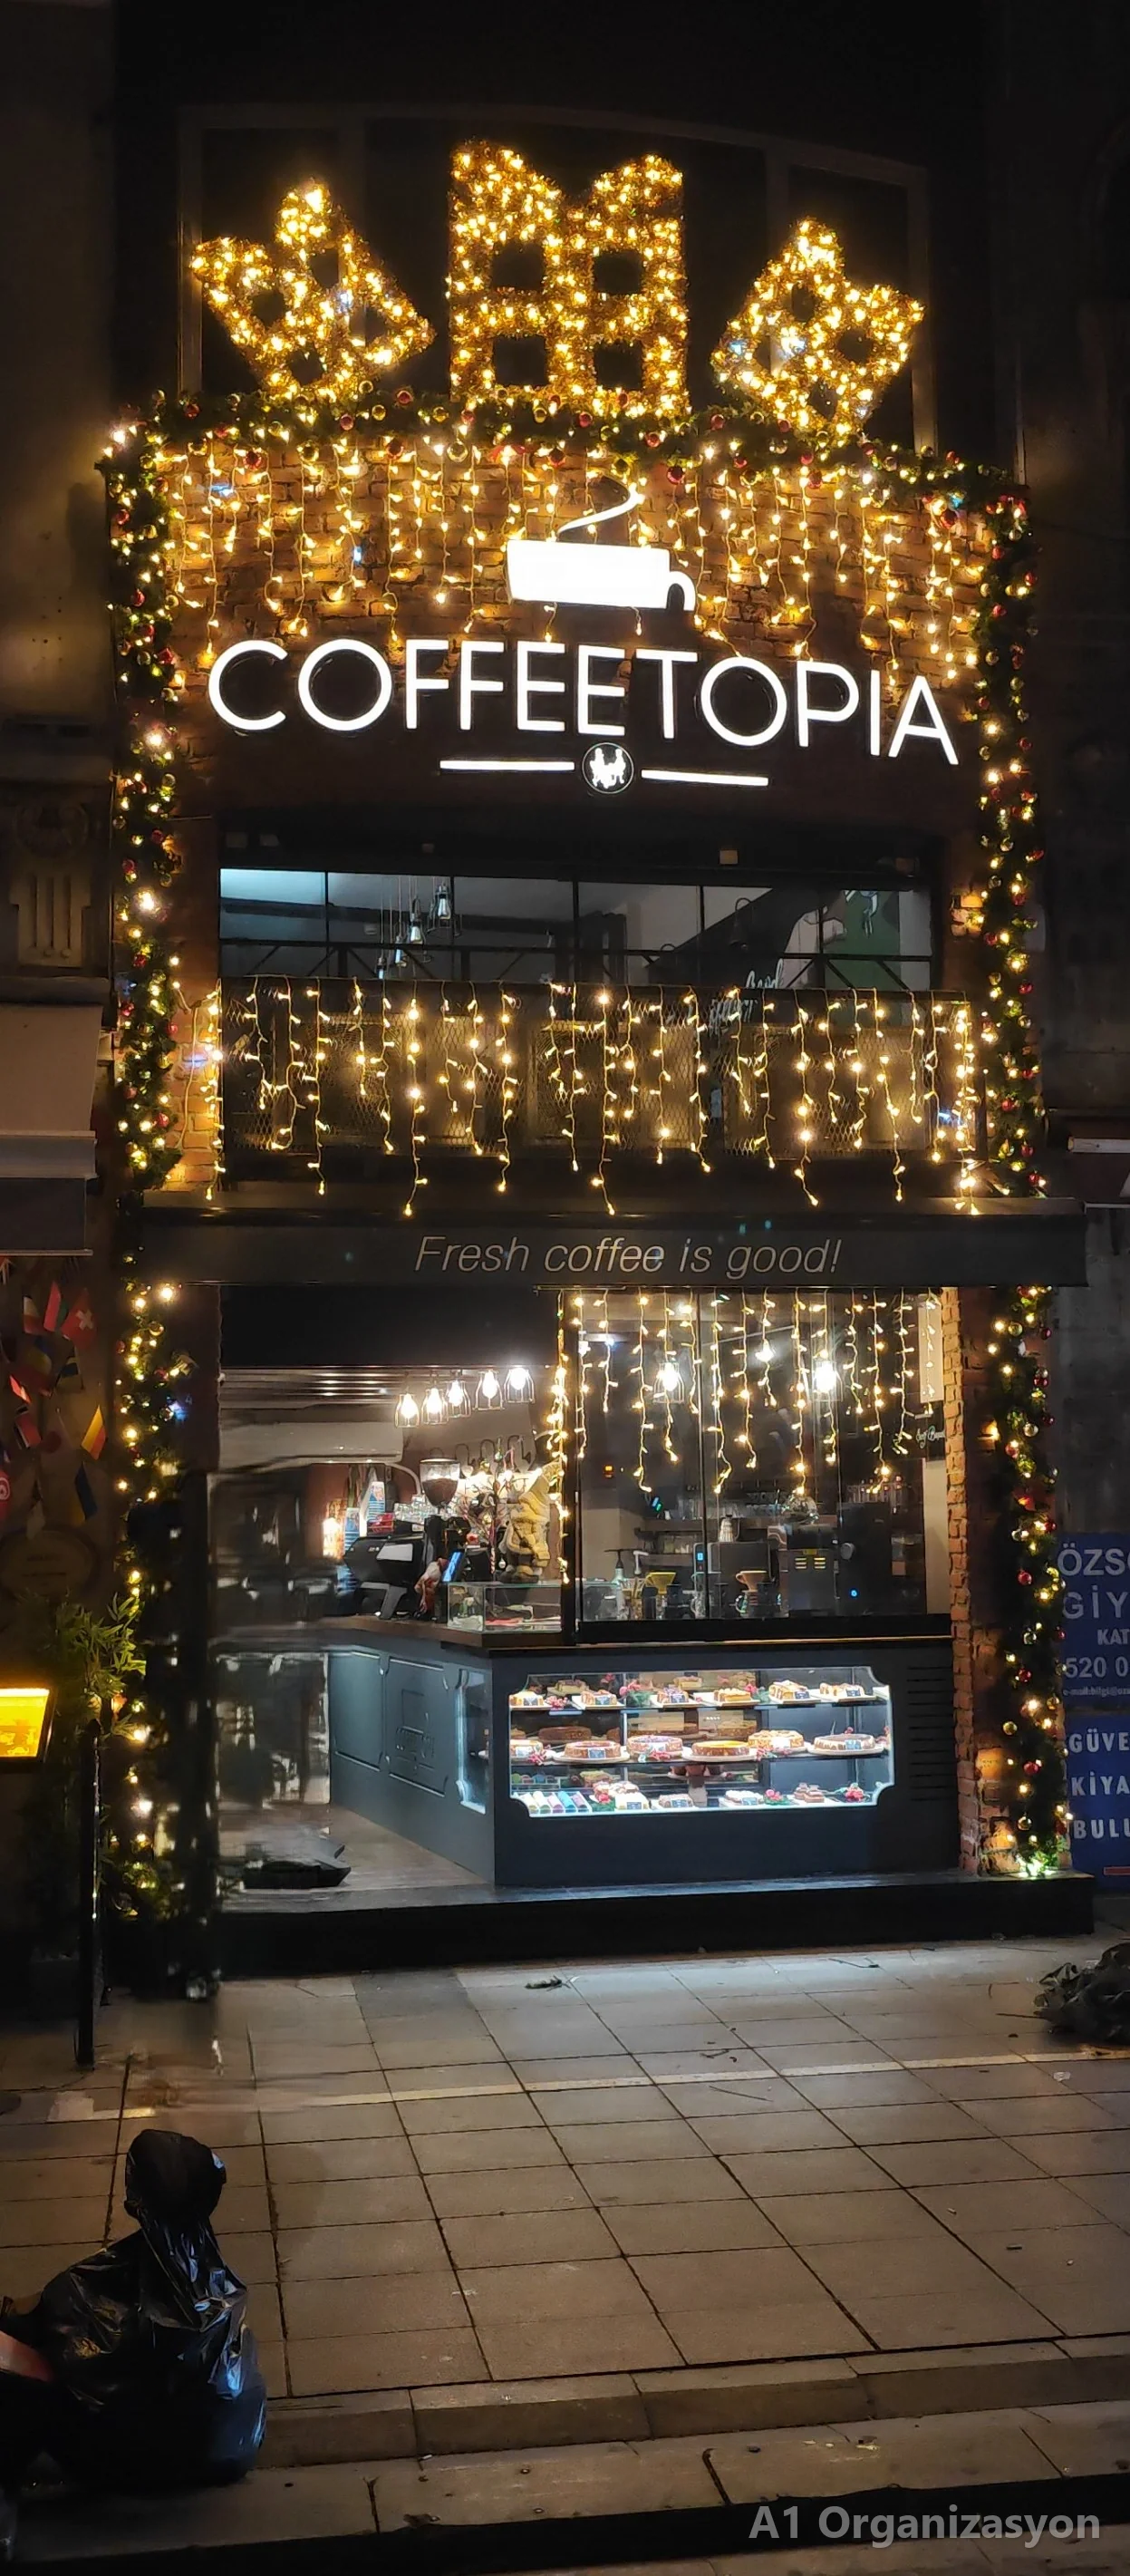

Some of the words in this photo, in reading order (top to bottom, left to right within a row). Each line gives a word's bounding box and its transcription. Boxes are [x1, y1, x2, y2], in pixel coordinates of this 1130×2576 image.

[208, 638, 958, 766] COFFEETOPIA
[414, 1235, 530, 1273] Fresh
[544, 1235, 665, 1273] coffee
[679, 1238, 712, 1273] is
[726, 1238, 842, 1280] good!
[1057, 1542, 1130, 1576] ÖZS
[1065, 1656, 1107, 1678] 520
